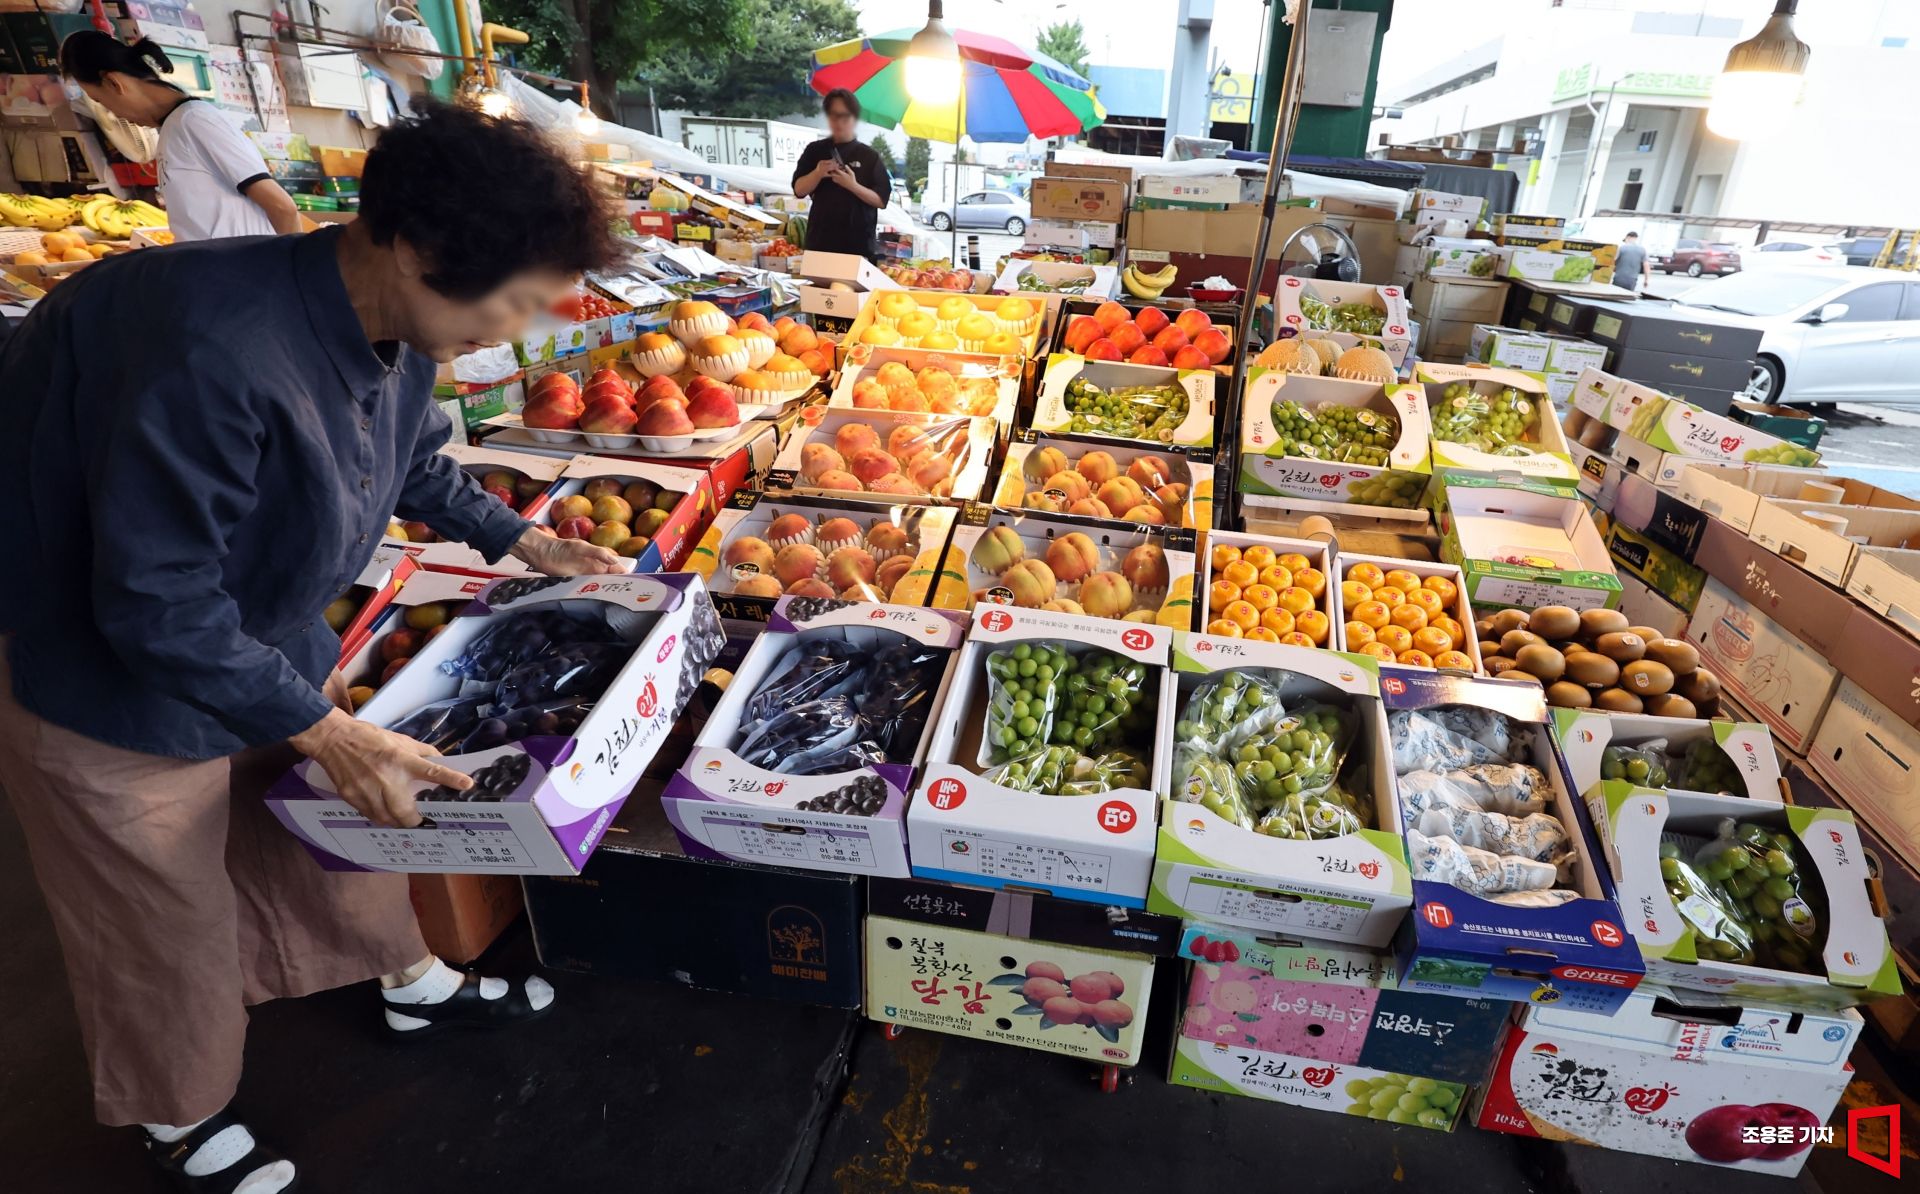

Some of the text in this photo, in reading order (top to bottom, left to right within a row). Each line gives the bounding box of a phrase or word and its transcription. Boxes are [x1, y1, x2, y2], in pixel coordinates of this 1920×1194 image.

[1688, 421, 1720, 446] 김천
[1278, 468, 1318, 484] 김천
[594, 718, 639, 776] 김천
[728, 778, 783, 796] 김천 앤
[1317, 855, 1378, 879] 김천 앤
[910, 936, 945, 956] 칠북
[911, 955, 974, 982] 봉황산
[1237, 1055, 1331, 1087] 김천 앤
[1627, 1089, 1661, 1114] 앤
[1494, 1112, 1527, 1129] 10 kg
